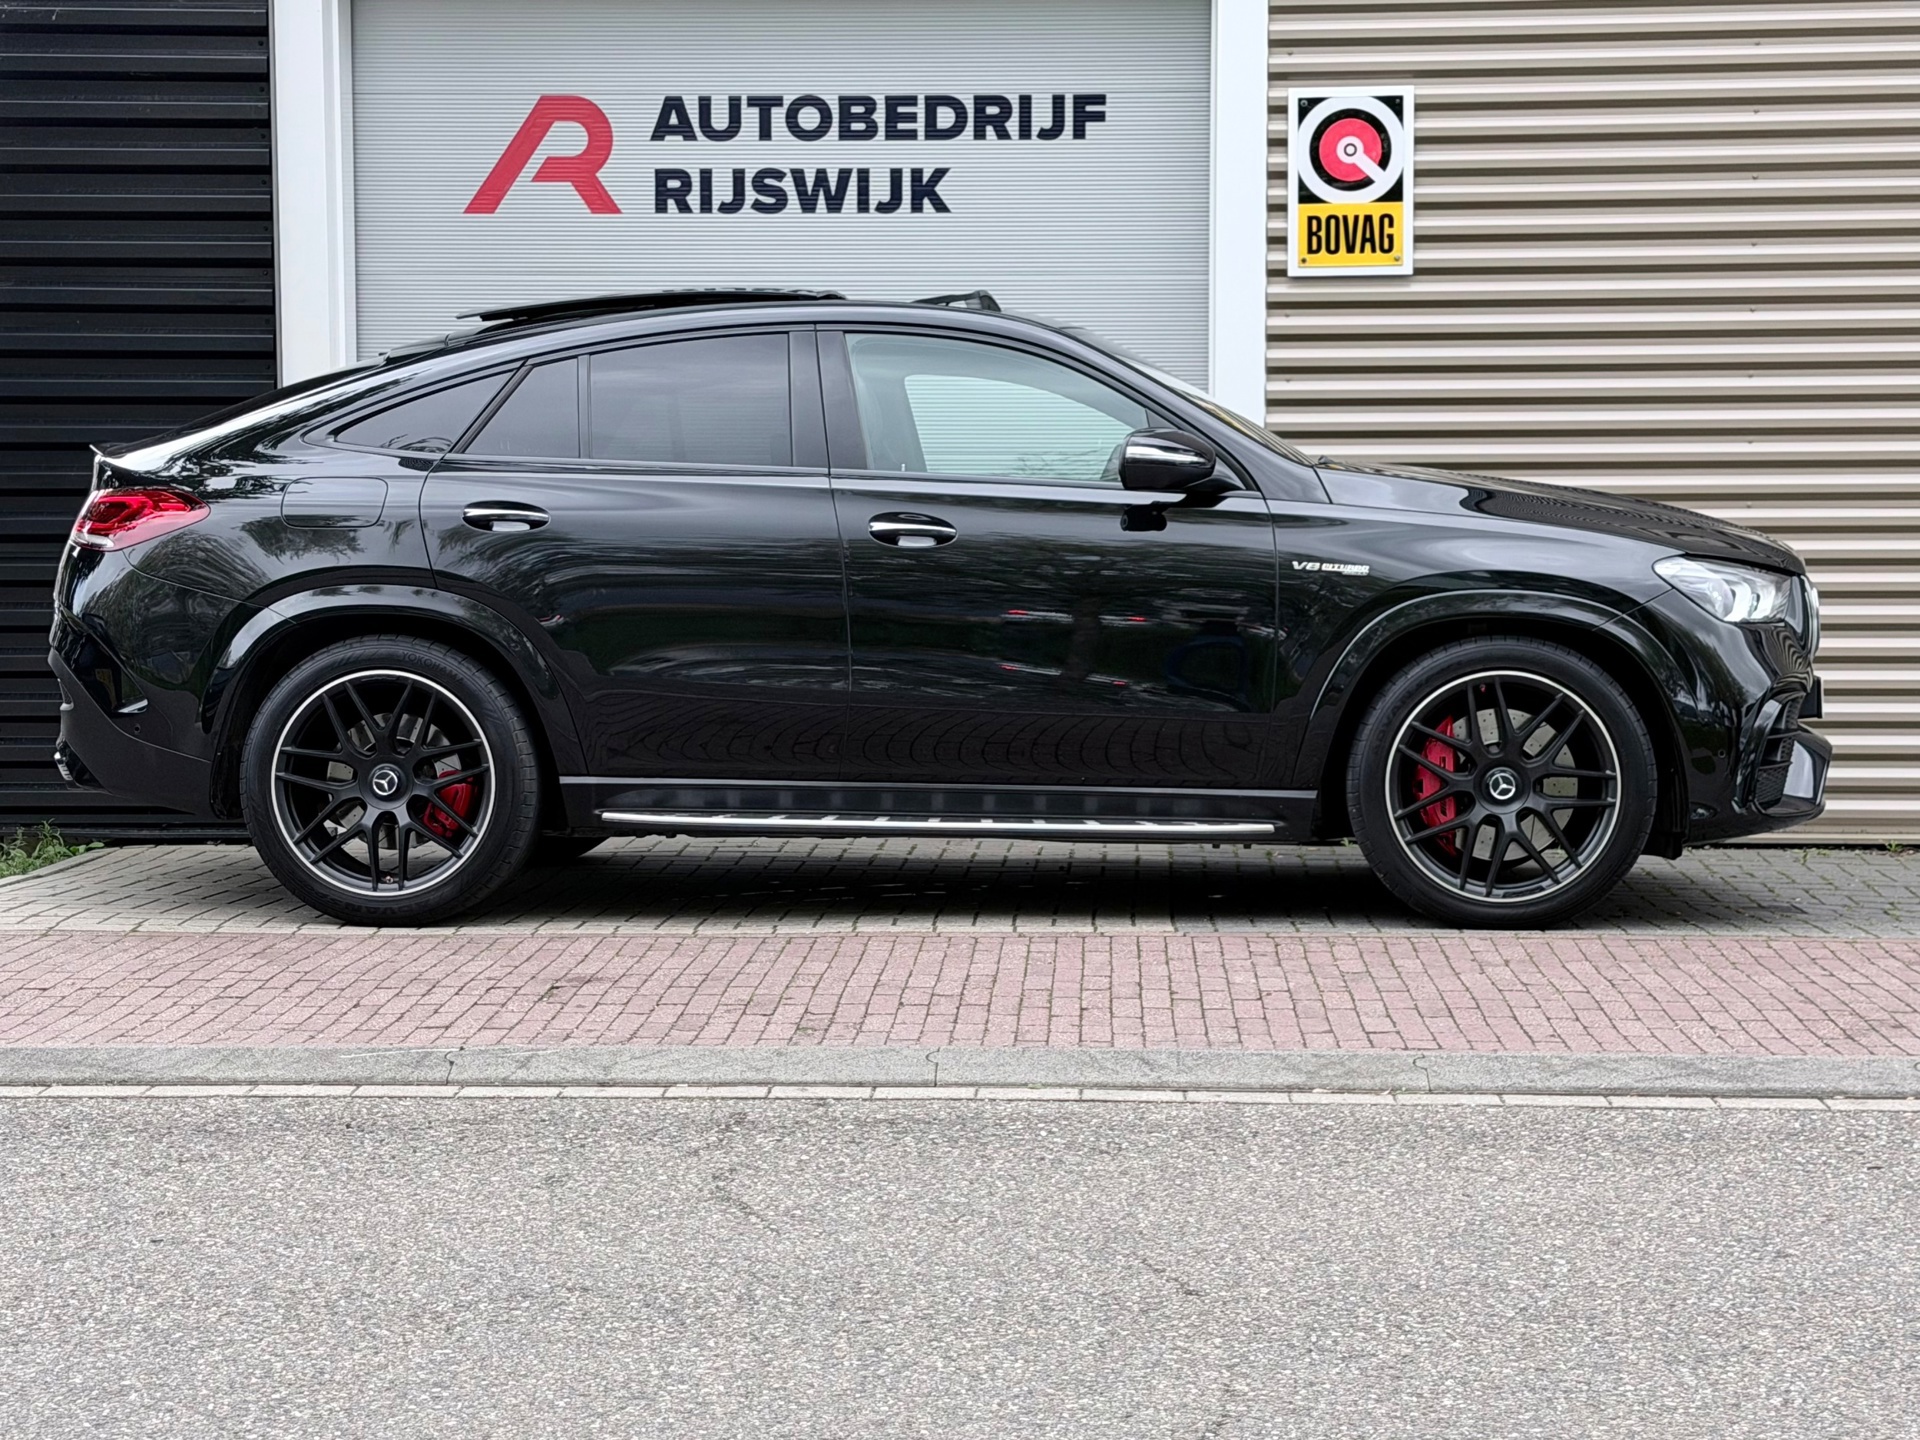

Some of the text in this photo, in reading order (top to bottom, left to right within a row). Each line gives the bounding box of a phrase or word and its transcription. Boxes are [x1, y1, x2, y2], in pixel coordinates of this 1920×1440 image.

[650, 94, 1107, 142] AUTOBEDRIJF
[654, 167, 951, 213] RIJSWIJK
[1306, 213, 1395, 255] BOVAG
